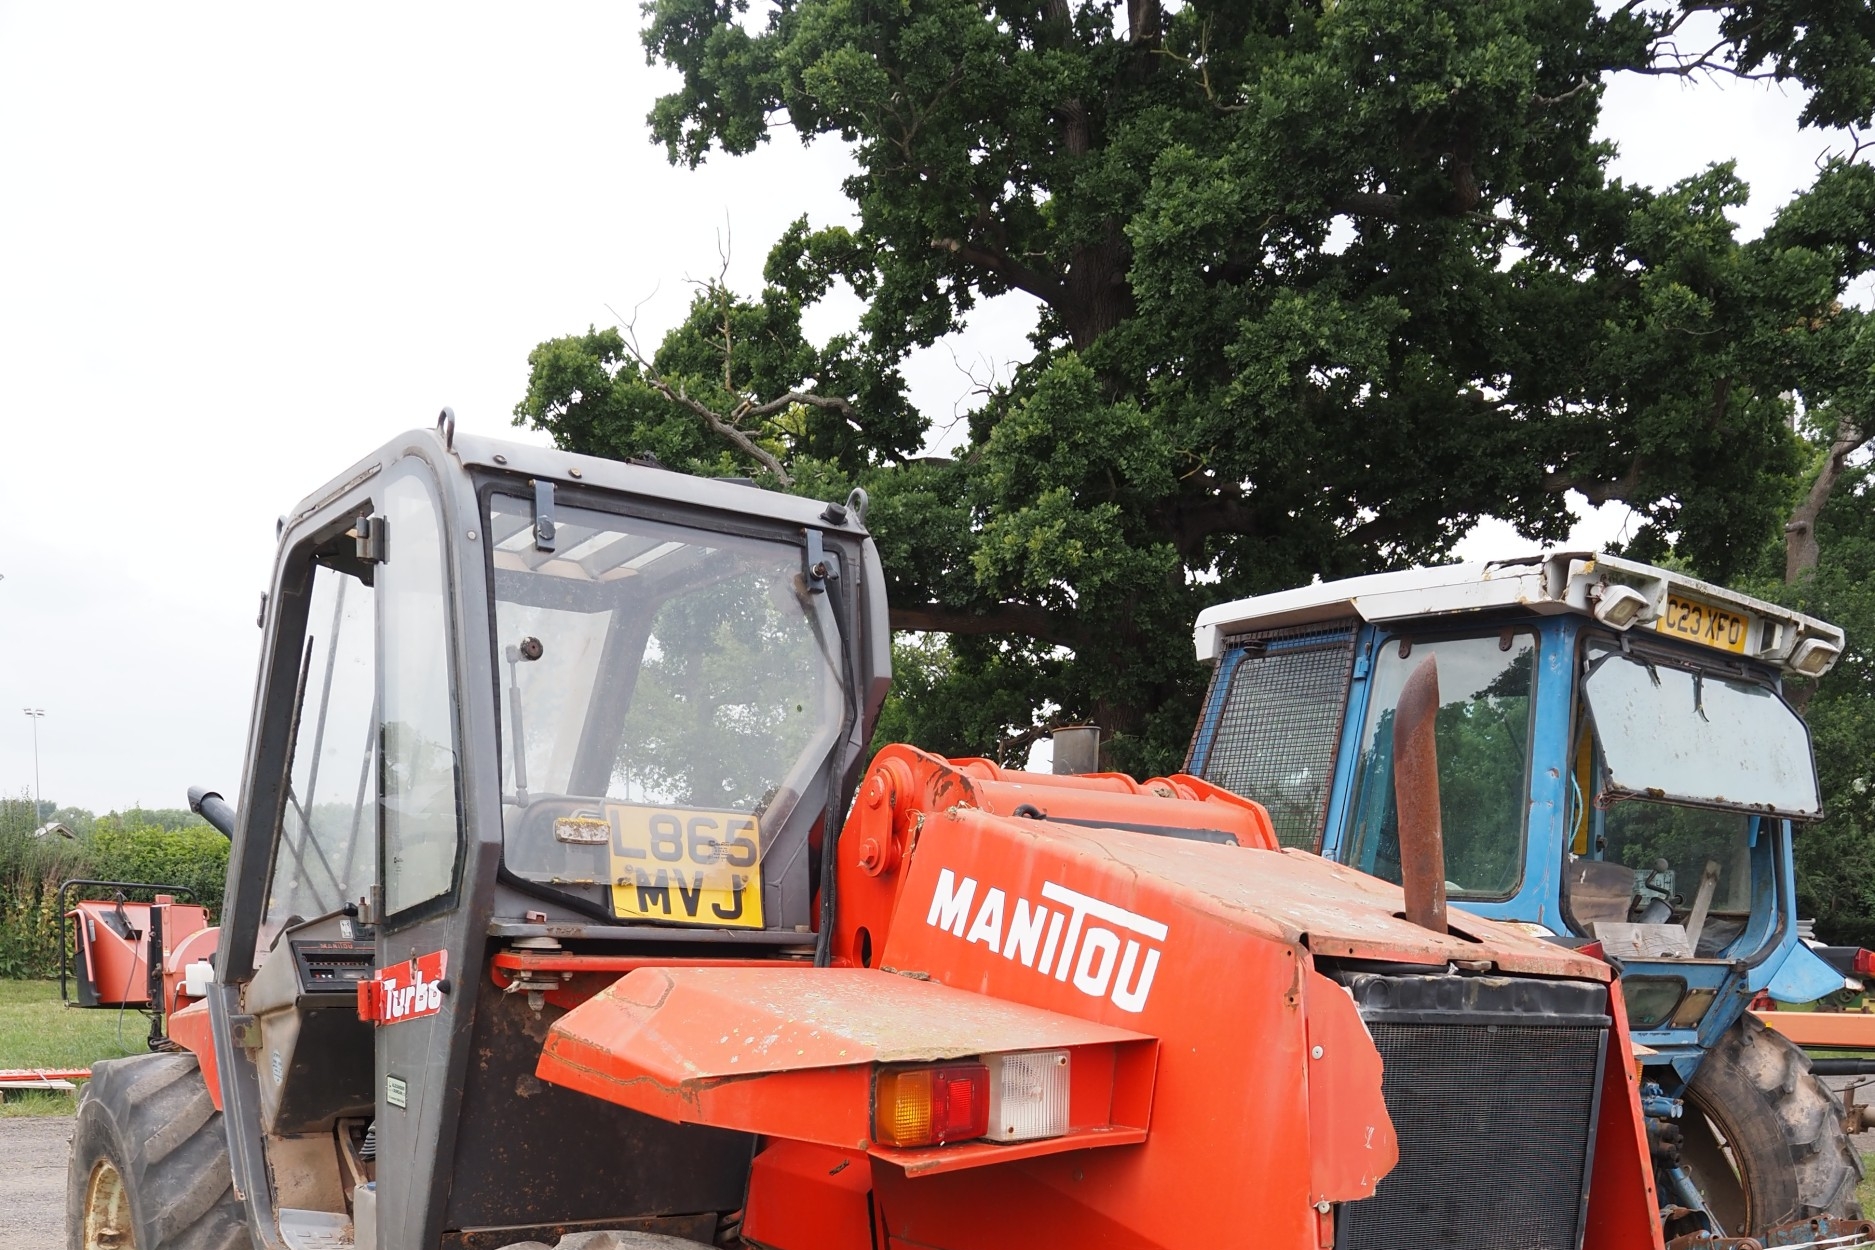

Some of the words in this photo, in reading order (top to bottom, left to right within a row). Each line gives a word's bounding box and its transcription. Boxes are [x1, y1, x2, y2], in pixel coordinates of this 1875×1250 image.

[1666, 600, 1703, 636] C23
[1706, 609, 1741, 645] XFO
[611, 810, 757, 867] L865
[635, 866, 744, 919] MVJ
[926, 868, 1168, 1013] MANITOU
[384, 971, 442, 1020] Turbo
